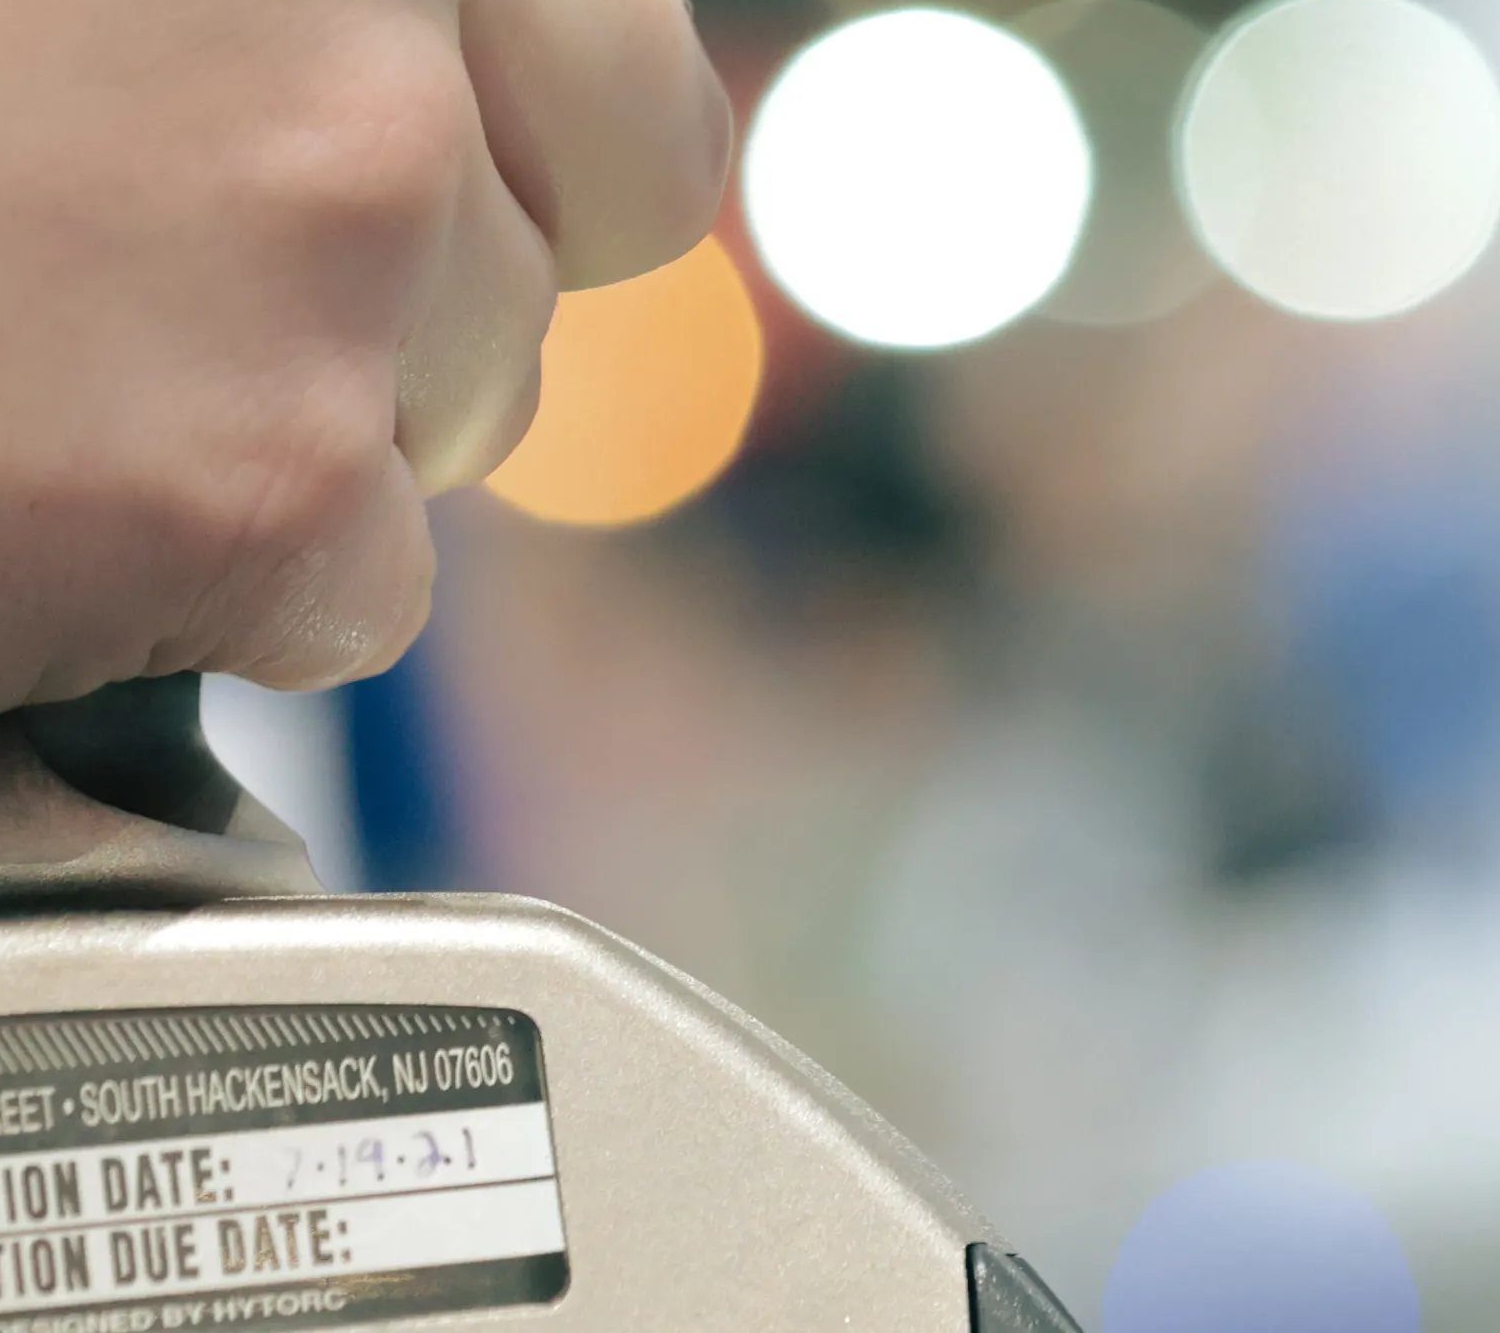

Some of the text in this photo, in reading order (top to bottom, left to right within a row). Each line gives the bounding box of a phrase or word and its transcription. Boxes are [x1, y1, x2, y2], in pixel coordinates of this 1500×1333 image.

[78, 1069, 183, 1128] SOUTH
[187, 1053, 391, 1117] HACKENSACK,
[392, 1051, 428, 1095] NJ
[434, 1041, 515, 1091] 07606
[100, 1146, 235, 1214] DATE:
[109, 1222, 199, 1287] DUE
[216, 1208, 353, 1276] DATE:
[162, 1301, 203, 1329] BY
[212, 1285, 348, 1323] HYTORC
